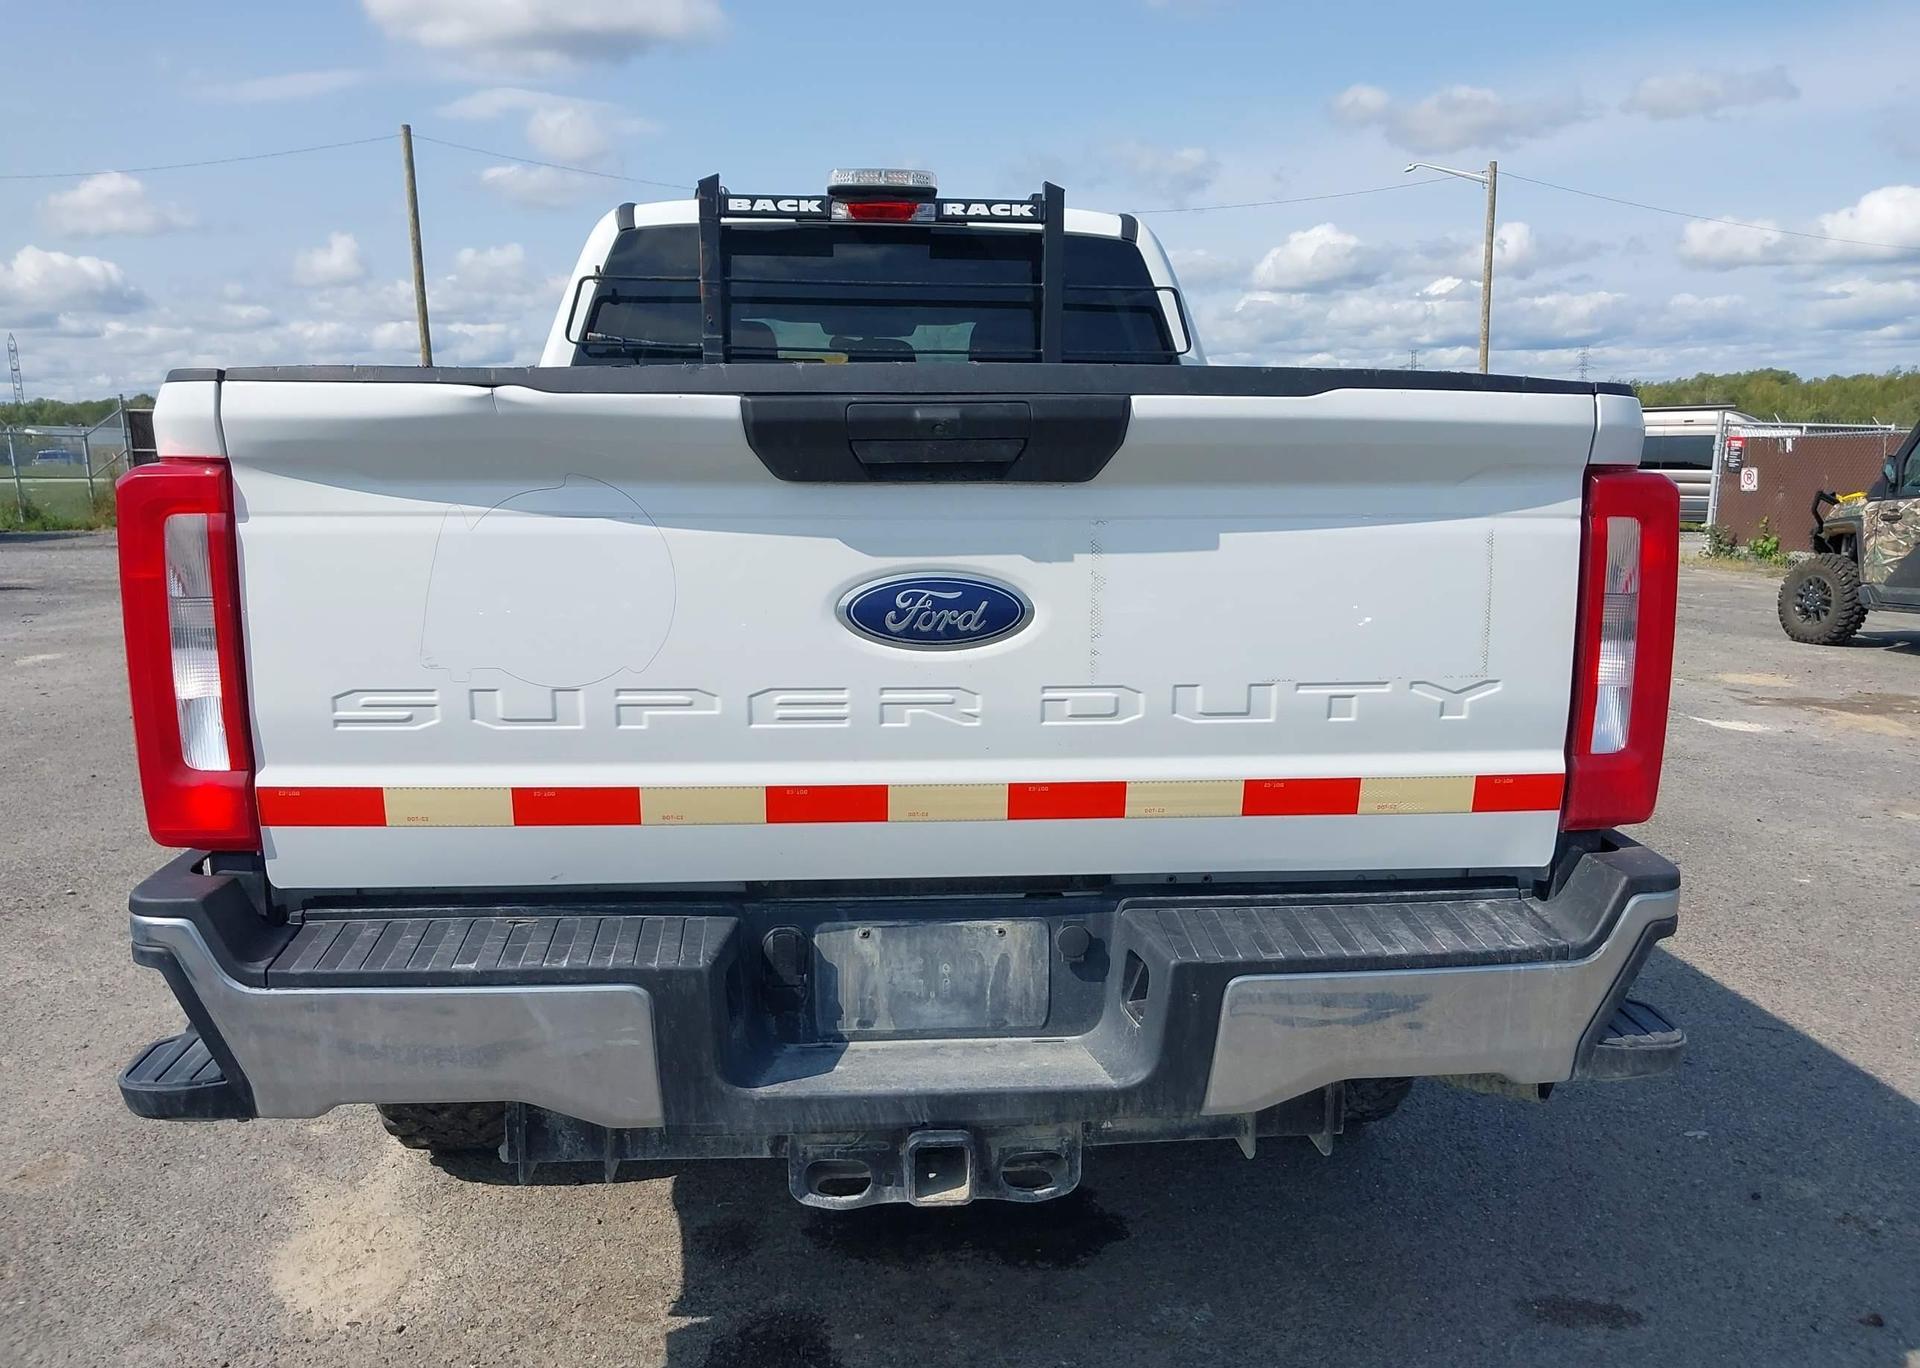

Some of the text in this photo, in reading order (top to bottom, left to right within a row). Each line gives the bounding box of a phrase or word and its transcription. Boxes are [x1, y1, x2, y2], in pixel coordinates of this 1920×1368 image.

[728, 198, 1036, 217] BACK RACK
[884, 589, 988, 633] Ford
[331, 679, 1503, 732] SUPER DUTY
